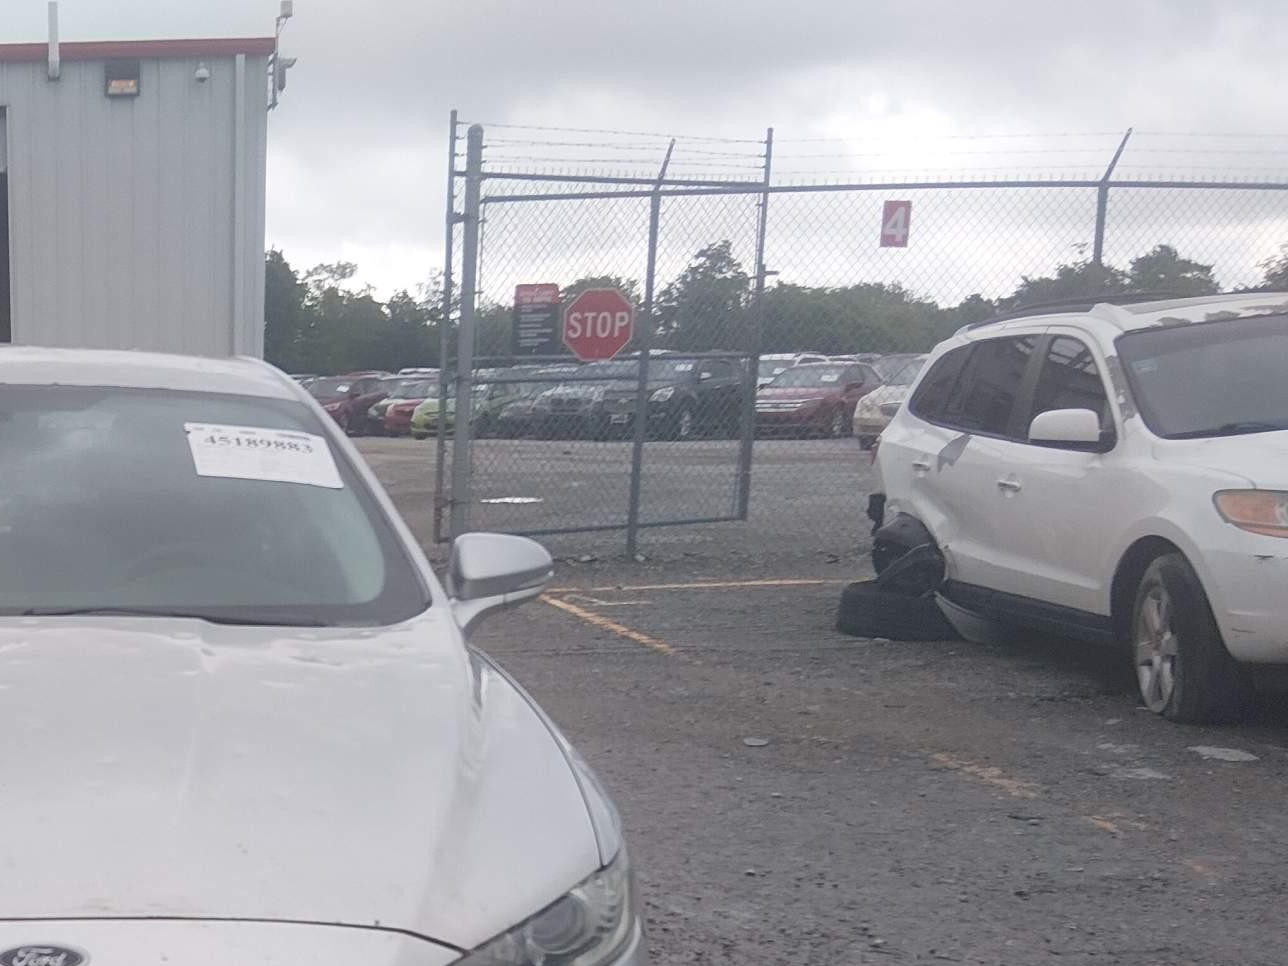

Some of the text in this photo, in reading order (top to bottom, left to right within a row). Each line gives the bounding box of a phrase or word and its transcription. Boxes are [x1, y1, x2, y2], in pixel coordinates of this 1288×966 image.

[884, 206, 908, 242] 4
[567, 311, 629, 338] STOP
[204, 435, 314, 454] 45189883
